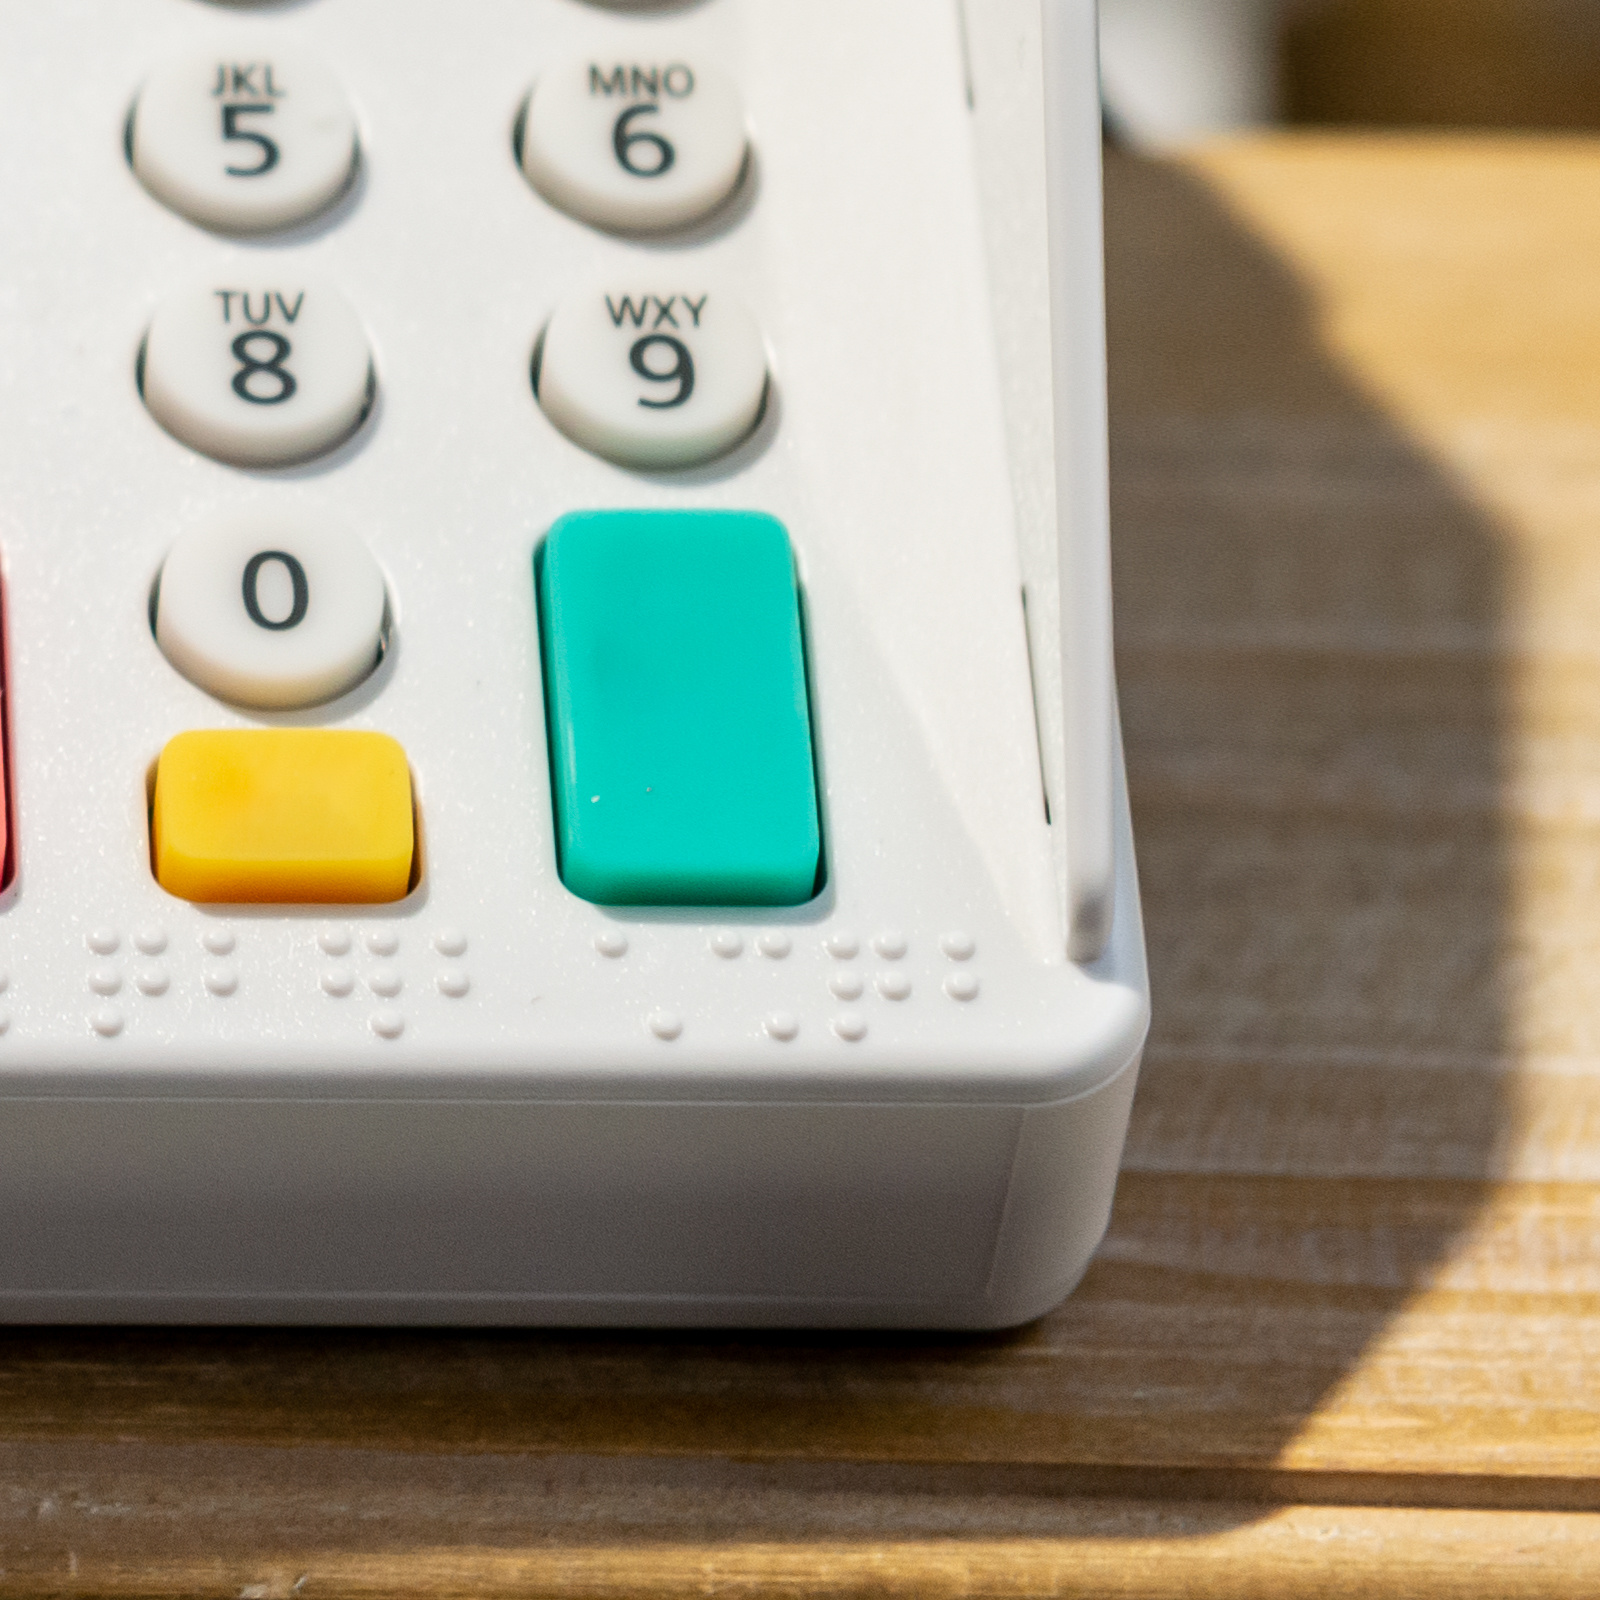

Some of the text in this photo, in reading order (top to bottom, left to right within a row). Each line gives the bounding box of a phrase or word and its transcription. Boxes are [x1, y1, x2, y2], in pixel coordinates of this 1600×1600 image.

[209, 62, 286, 101] JKL
[587, 64, 696, 103] MNO
[219, 101, 281, 178] 5
[611, 103, 677, 179] 6
[215, 289, 306, 326] TUV
[604, 293, 709, 330] WXY
[230, 328, 298, 407] 8
[628, 332, 697, 411] 9
[241, 550, 310, 633] 0
